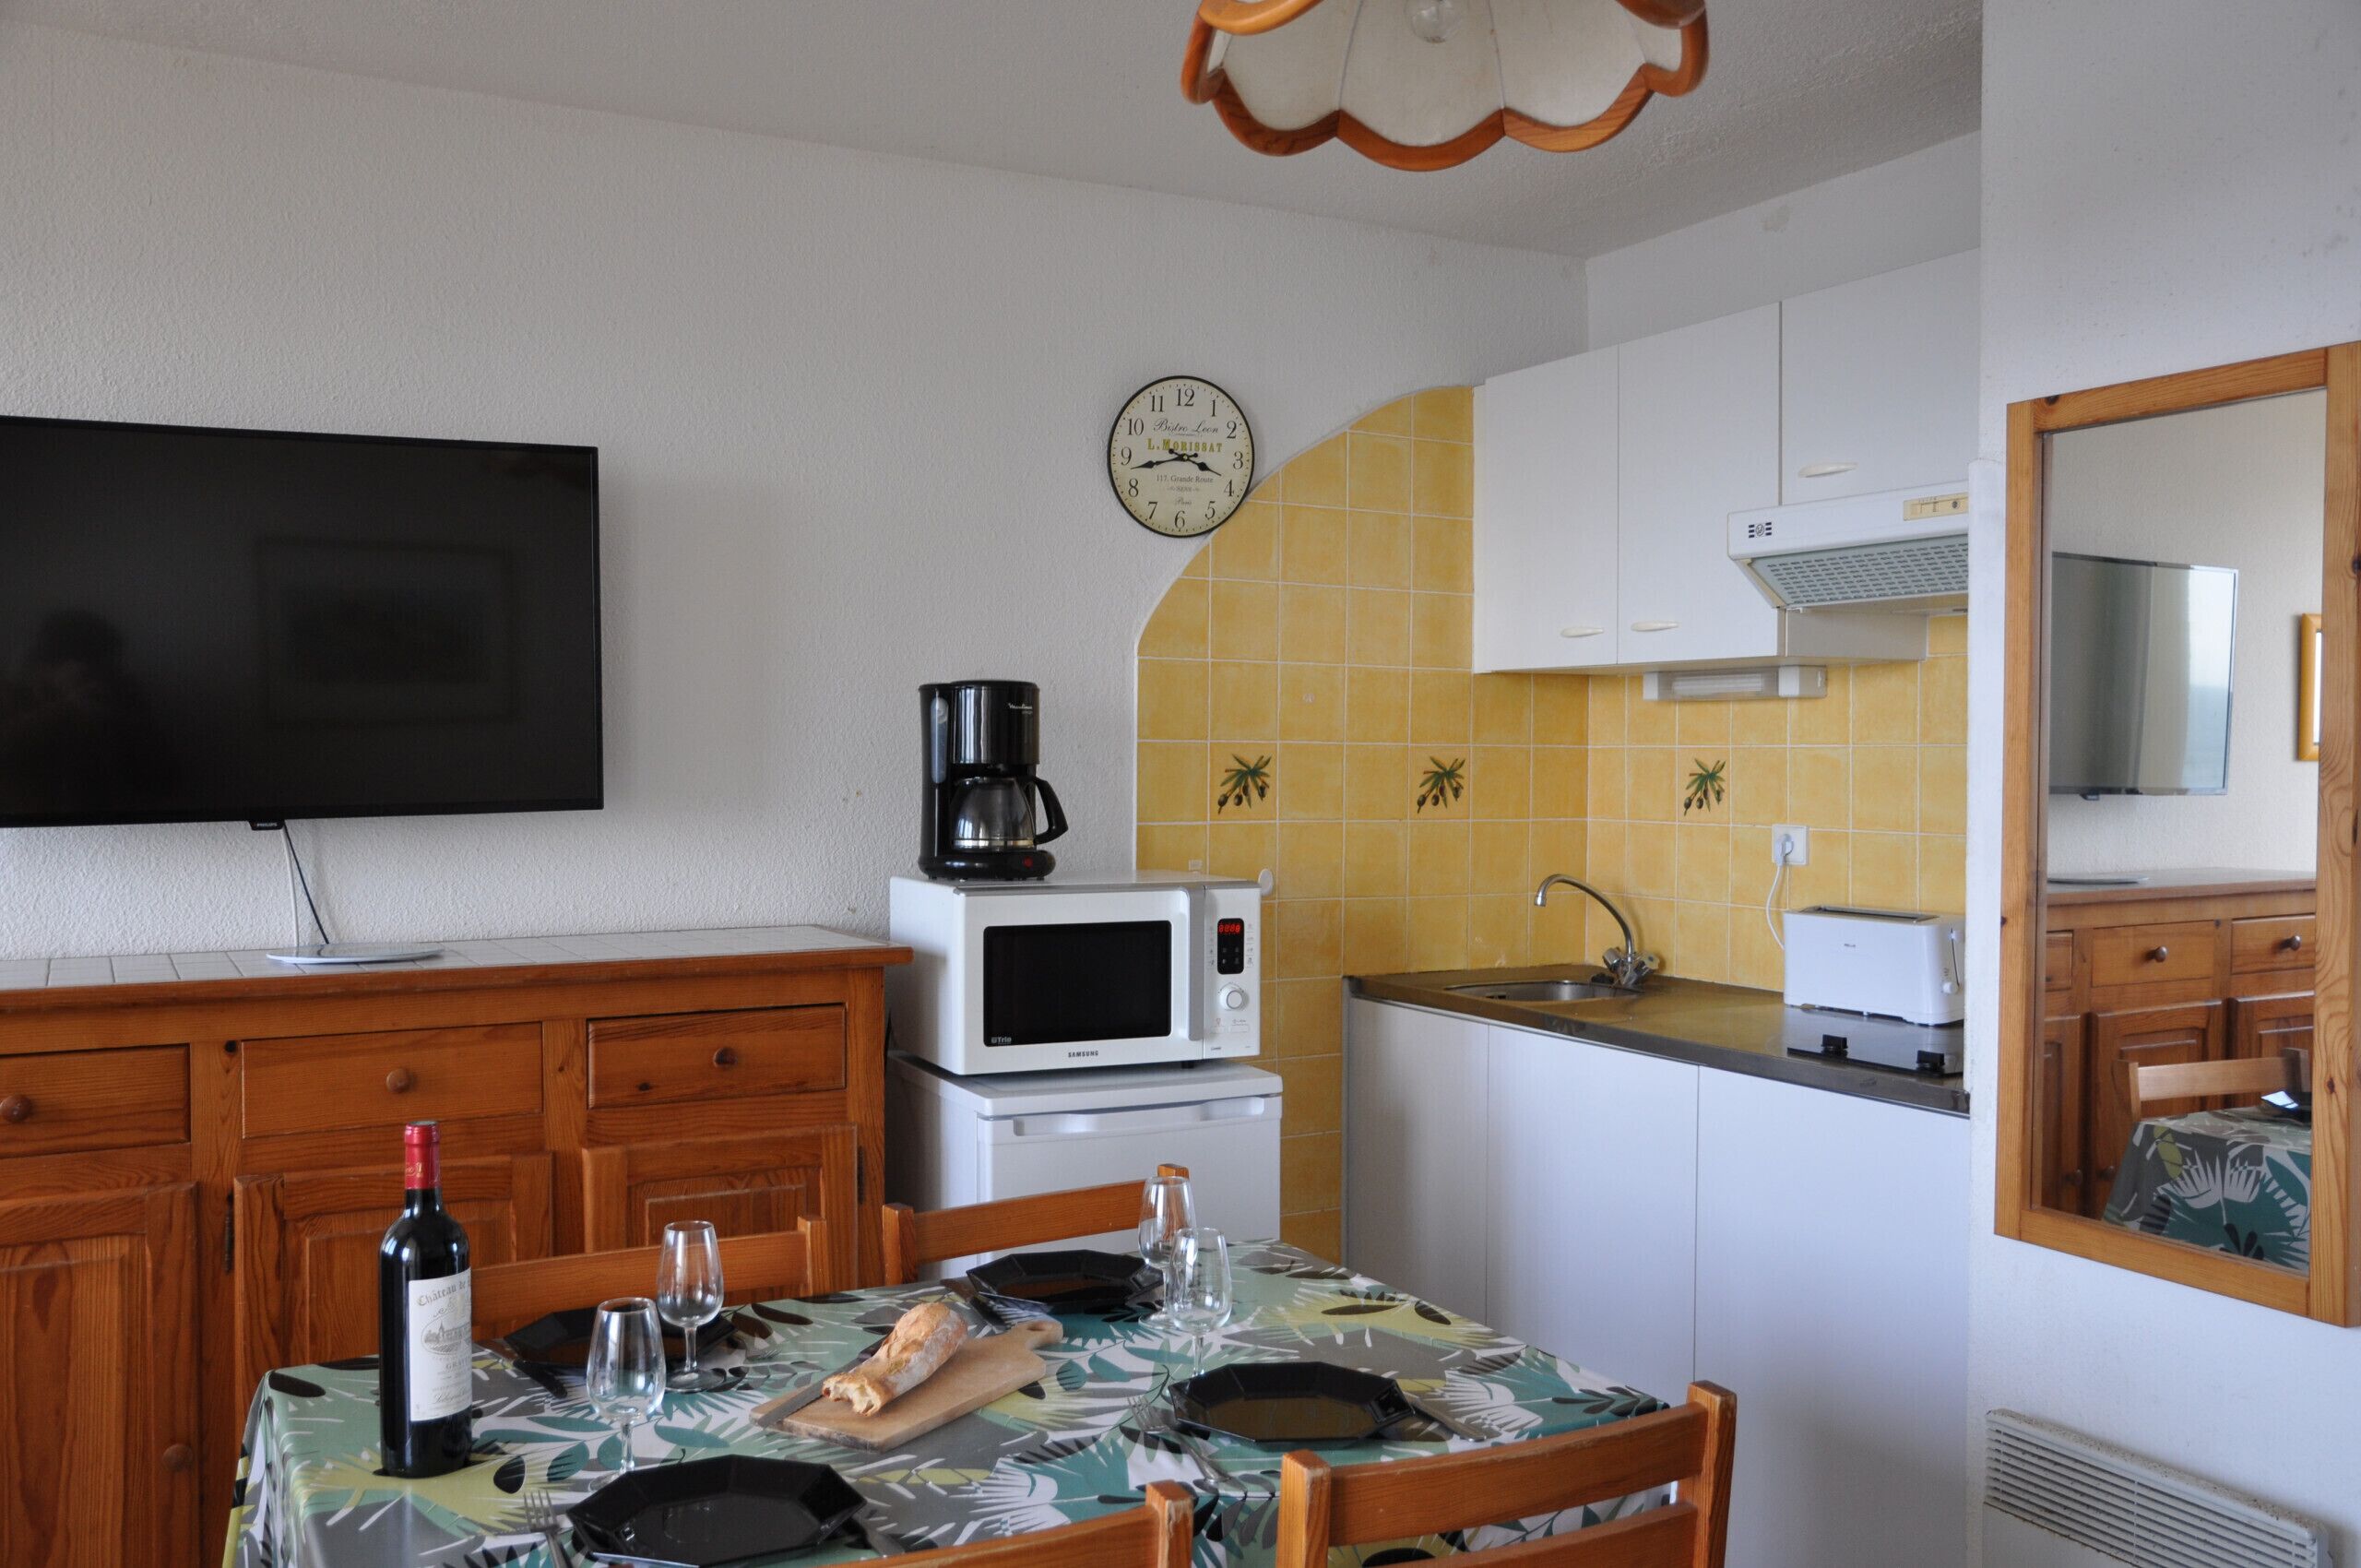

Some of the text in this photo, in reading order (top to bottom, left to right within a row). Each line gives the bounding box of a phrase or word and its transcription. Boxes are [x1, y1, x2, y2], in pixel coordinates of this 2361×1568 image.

[1151, 395, 1164, 412] 11
[1175, 388, 1195, 407] 12
[1210, 399, 1216, 417] 1
[1127, 418, 1145, 435] 10
[1226, 421, 1237, 439] 2
[1121, 446, 1133, 466] 9
[1232, 451, 1243, 469] 3
[1128, 478, 1139, 497] 8
[1223, 479, 1234, 497] 4
[1147, 501, 1158, 520] 7
[1204, 500, 1216, 520] 5
[1174, 510, 1185, 529] 6
[1068, 1050, 1099, 1058] SAMSUNG
